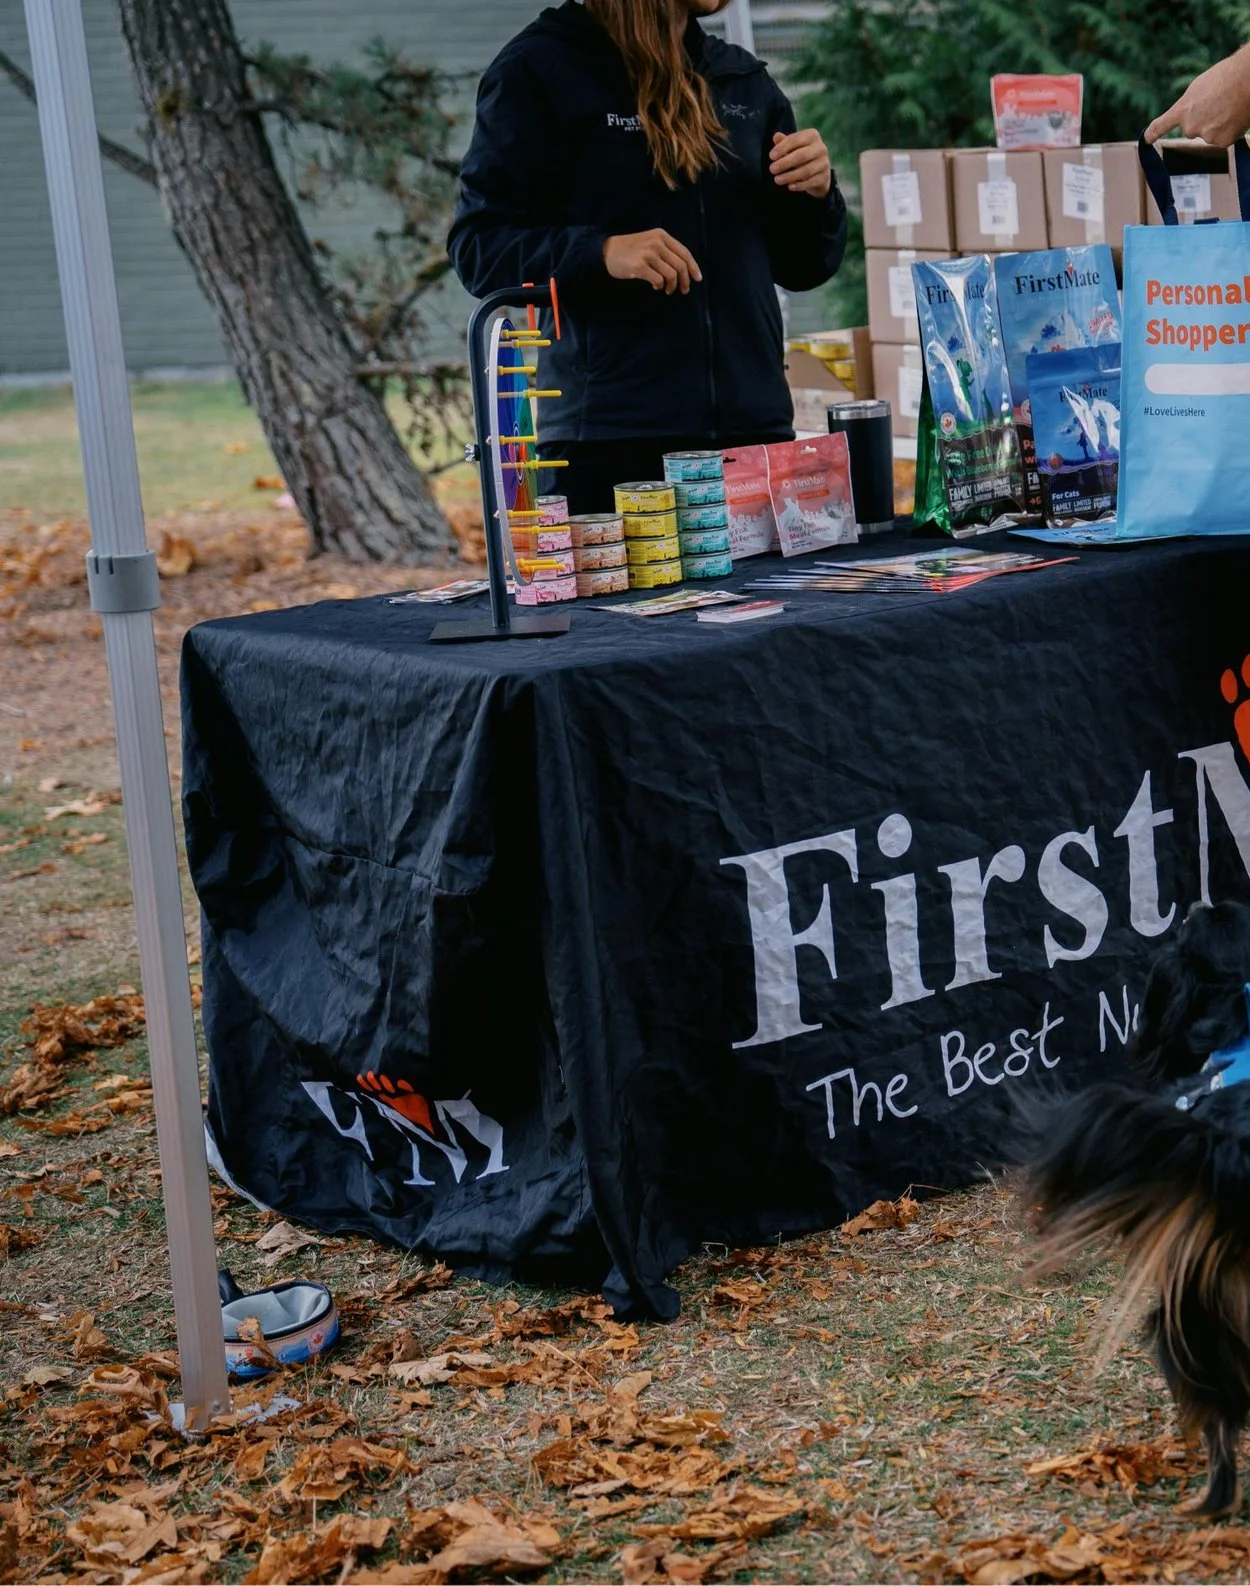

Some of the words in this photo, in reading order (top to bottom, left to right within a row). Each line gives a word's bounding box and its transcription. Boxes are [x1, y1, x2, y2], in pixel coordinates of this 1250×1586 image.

[1015, 268, 1100, 295] FirstMate
[1146, 318, 1250, 351] Shopper
[1144, 406, 1206, 416] #LoveLivesHere
[1052, 493, 1064, 501] For
[1064, 490, 1080, 499] Cats
[806, 1067, 918, 1139] The
[940, 1001, 1064, 1097] Best
